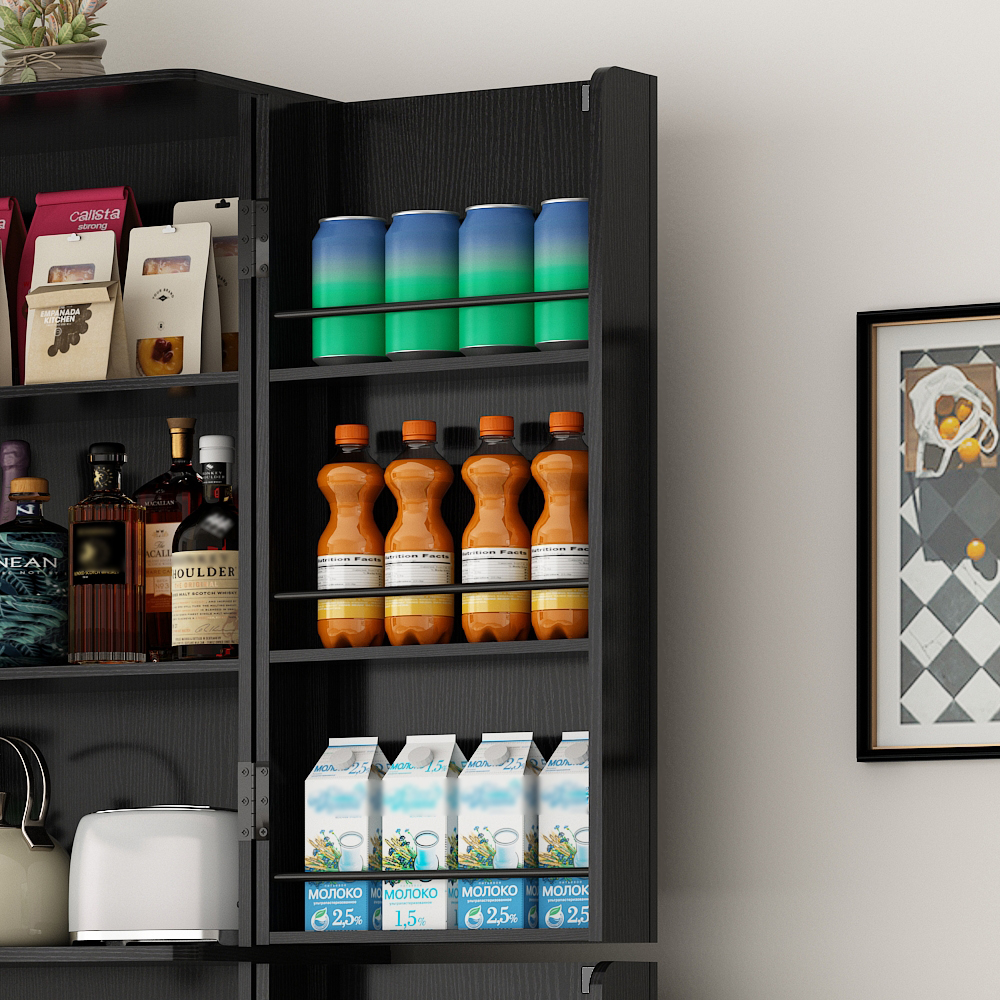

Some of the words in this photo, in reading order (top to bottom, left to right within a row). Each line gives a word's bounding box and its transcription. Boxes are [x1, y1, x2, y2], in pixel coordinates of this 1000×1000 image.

[40, 308, 81, 317] EMPANADA
[44, 315, 76, 324] KITCHEN
[146, 550, 172, 558] ACALL
[172, 566, 235, 579] HOULDER
[308, 888, 363, 900] МОЛОКО
[384, 888, 439, 900] МОЛОКО
[462, 885, 518, 898] МОЛОКО
[542, 884, 589, 897] МОЛОК
[332, 908, 363, 928] 2,5%
[394, 909, 426, 929] 1,5%
[486, 906, 518, 926] 2,5%
[567, 905, 589, 925] 2,5
